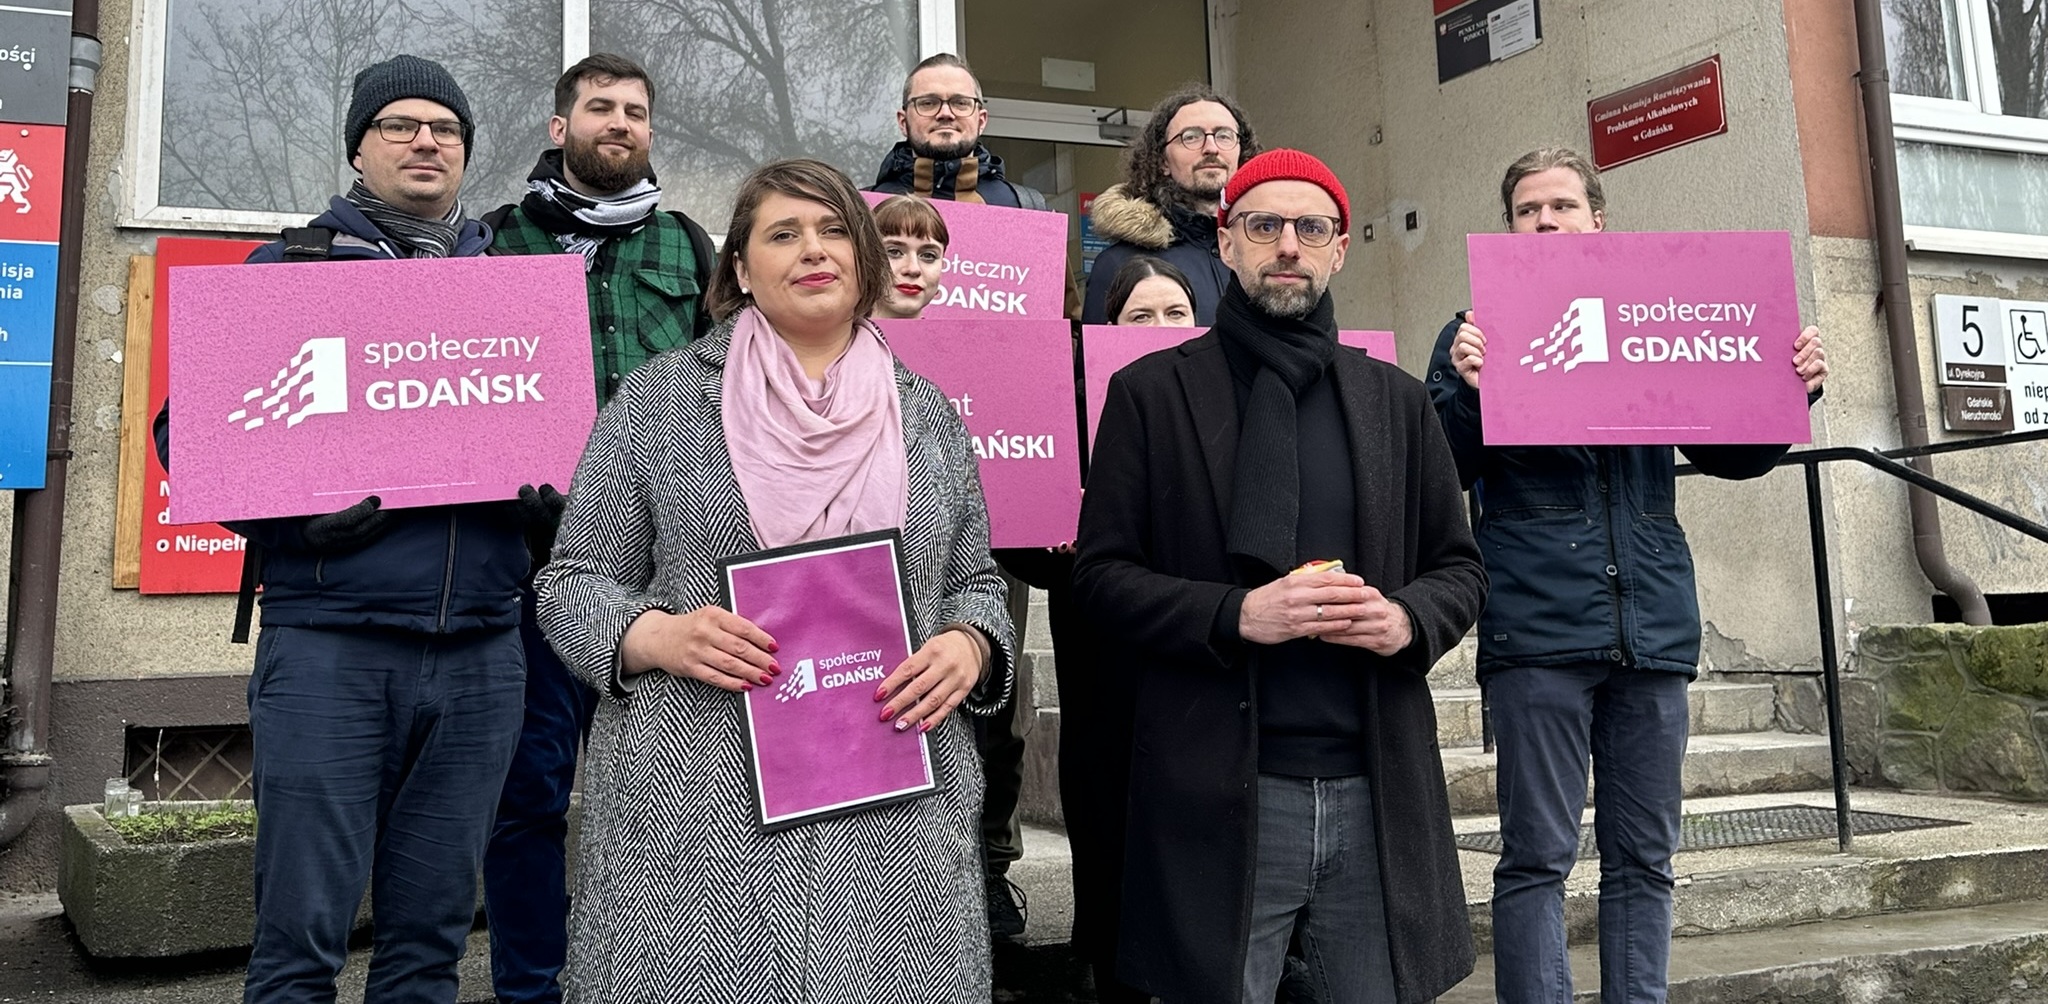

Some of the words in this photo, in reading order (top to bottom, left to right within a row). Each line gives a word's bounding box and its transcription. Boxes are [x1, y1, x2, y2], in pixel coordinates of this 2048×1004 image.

[1594, 107, 1621, 123] Gminna
[1622, 97, 1651, 113] Komisja
[1653, 76, 1711, 103] Rozwiązywania
[1606, 113, 1644, 135] Problemów
[1645, 96, 1698, 122] Alkoholowych
[1632, 132, 1640, 142] w
[1640, 122, 1674, 140] Gdańsku
[1617, 296, 1757, 327] społeczny
[1962, 305, 1984, 358] 5
[364, 332, 540, 369] społeczny
[1621, 330, 1763, 363] GDAŃSK
[365, 369, 545, 411] GDAŃSK
[1966, 396, 1994, 408] Gdańskie
[1961, 409, 2002, 421] Nieruchomości
[2024, 407, 2039, 424] od
[156, 539, 170, 552] o
[818, 649, 882, 671] społeczny
[821, 665, 886, 689] GDAŃSK
